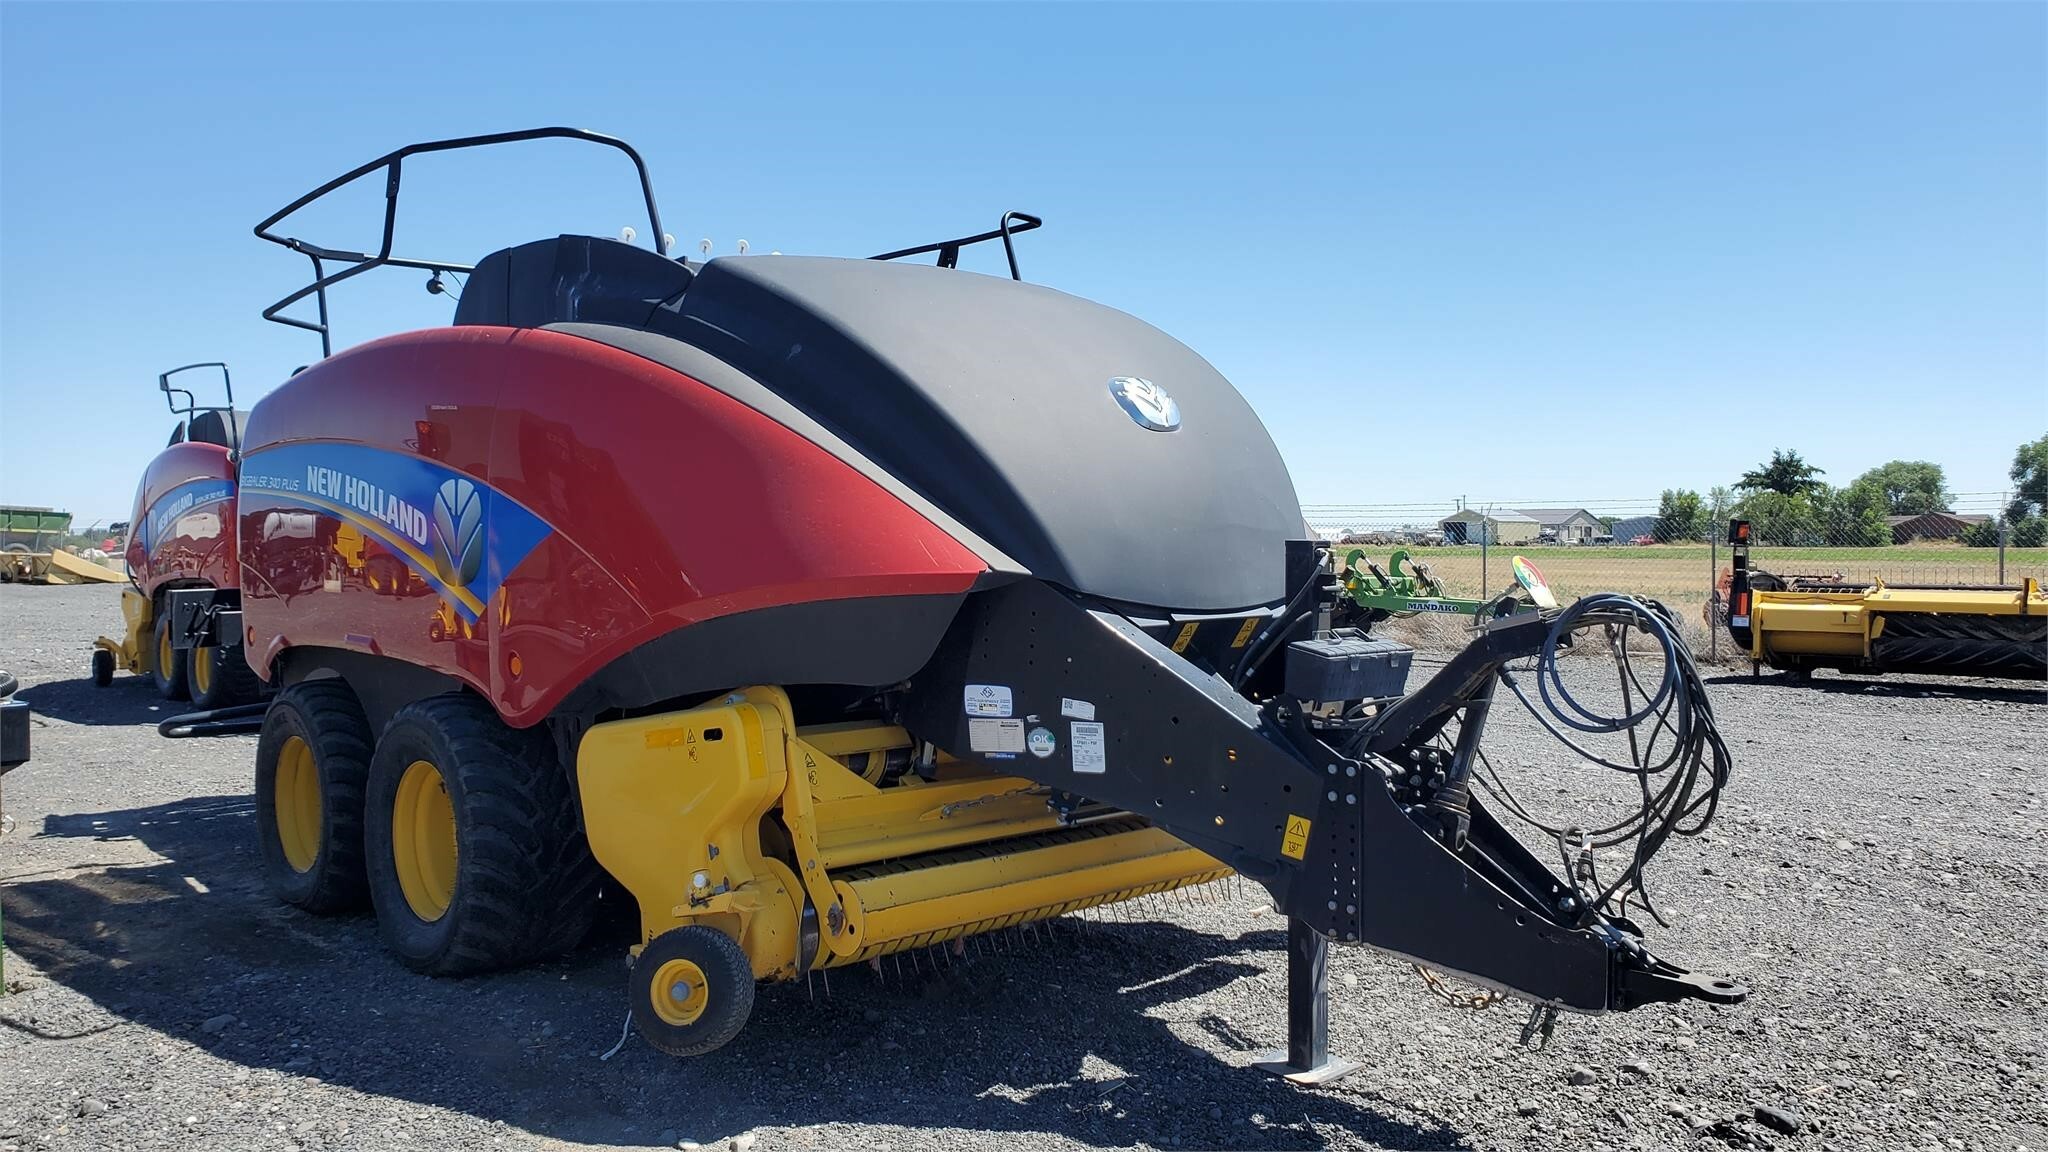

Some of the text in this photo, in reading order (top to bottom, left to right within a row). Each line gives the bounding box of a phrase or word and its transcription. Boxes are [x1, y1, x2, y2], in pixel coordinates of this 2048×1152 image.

[281, 478, 300, 491] PLUS
[307, 465, 428, 546] NEW HOLLAND
[157, 510, 169, 535] NEW
[168, 492, 193, 522] HOLLAND
[1407, 602, 1459, 612] MANDAKO
[1033, 735, 1049, 744] OK
